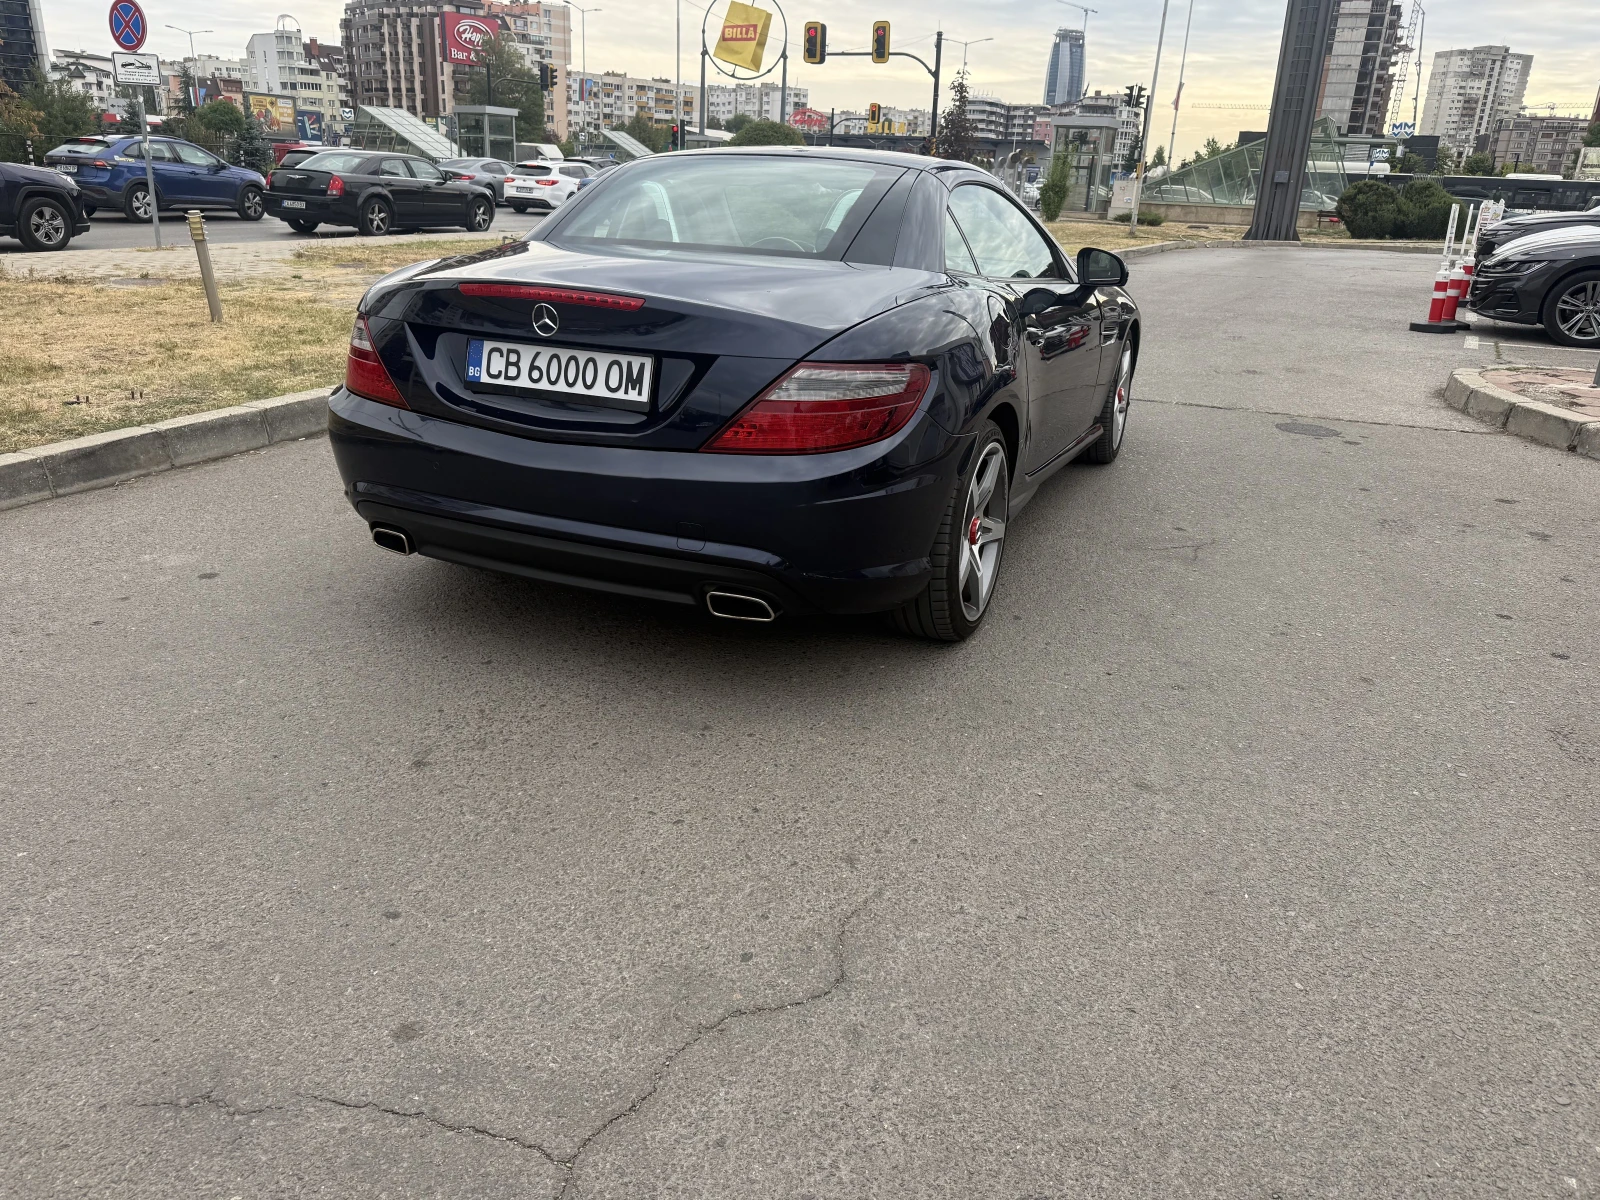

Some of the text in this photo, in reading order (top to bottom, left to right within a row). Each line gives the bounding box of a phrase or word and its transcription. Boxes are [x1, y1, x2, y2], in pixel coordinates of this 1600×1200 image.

[458, 25, 490, 47] Happ
[724, 27, 755, 39] BILLA
[450, 47, 468, 60] Bar
[468, 366, 481, 377] BG
[485, 346, 646, 397] CB 6000 OM
